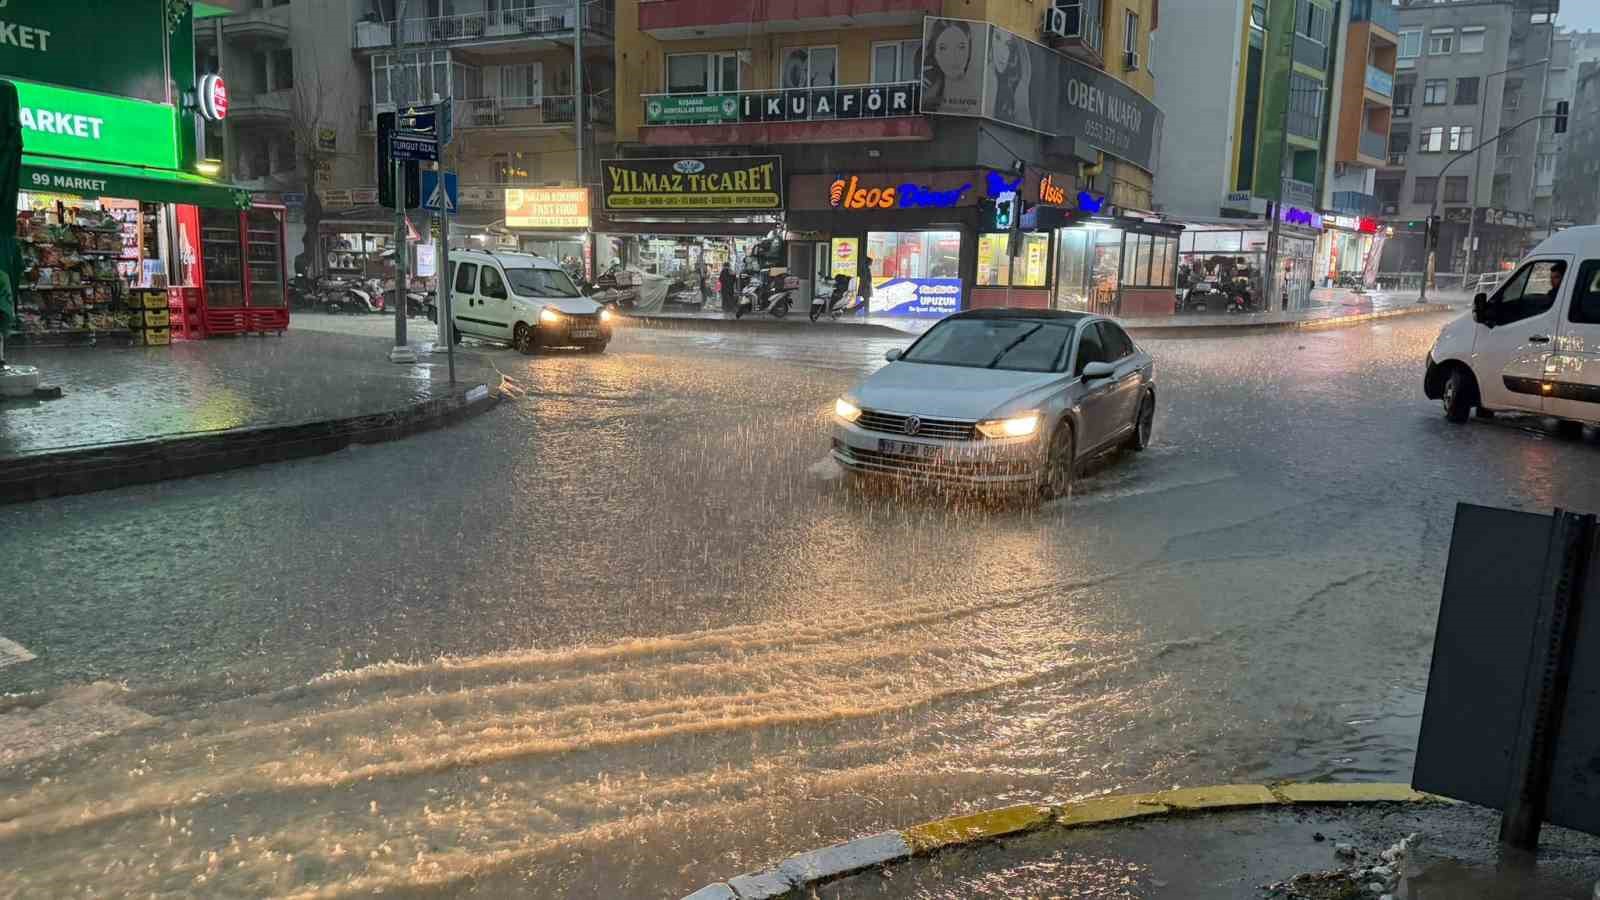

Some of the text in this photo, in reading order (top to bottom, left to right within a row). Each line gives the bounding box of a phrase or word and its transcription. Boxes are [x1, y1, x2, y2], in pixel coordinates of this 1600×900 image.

[1067, 78, 1105, 116] OBEN
[393, 141, 436, 152] TURGUT ÖZAL
[32, 173, 107, 191] 99 MARKET
[608, 165, 684, 193] YILMAZ
[919, 296, 956, 306] UPUZUN
